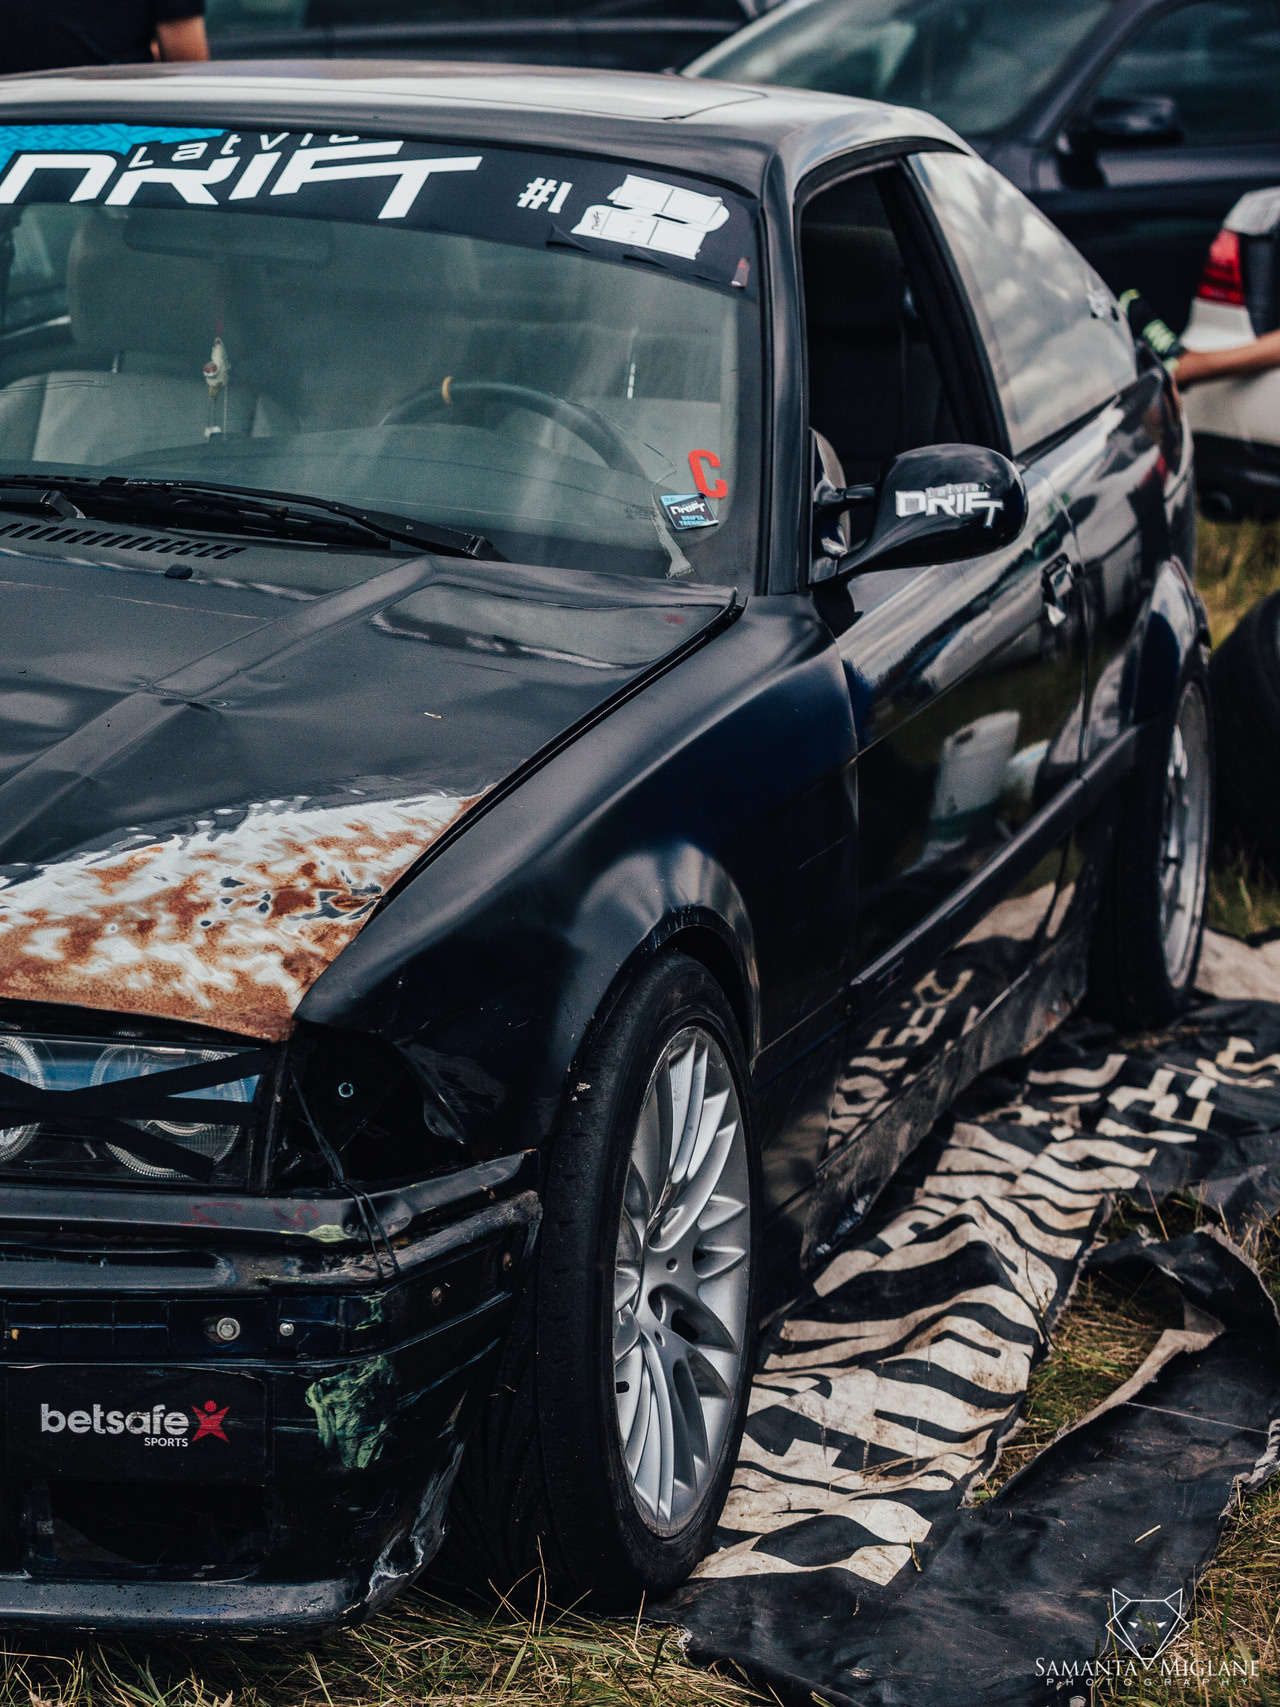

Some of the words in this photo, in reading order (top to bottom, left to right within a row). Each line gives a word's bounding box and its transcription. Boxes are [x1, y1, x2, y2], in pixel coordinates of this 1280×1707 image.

[687, 448, 729, 499] C
[894, 490, 1004, 529] DRIFT
[40, 1403, 190, 1436] betsafe
[144, 1437, 188, 1447] SPORTS
